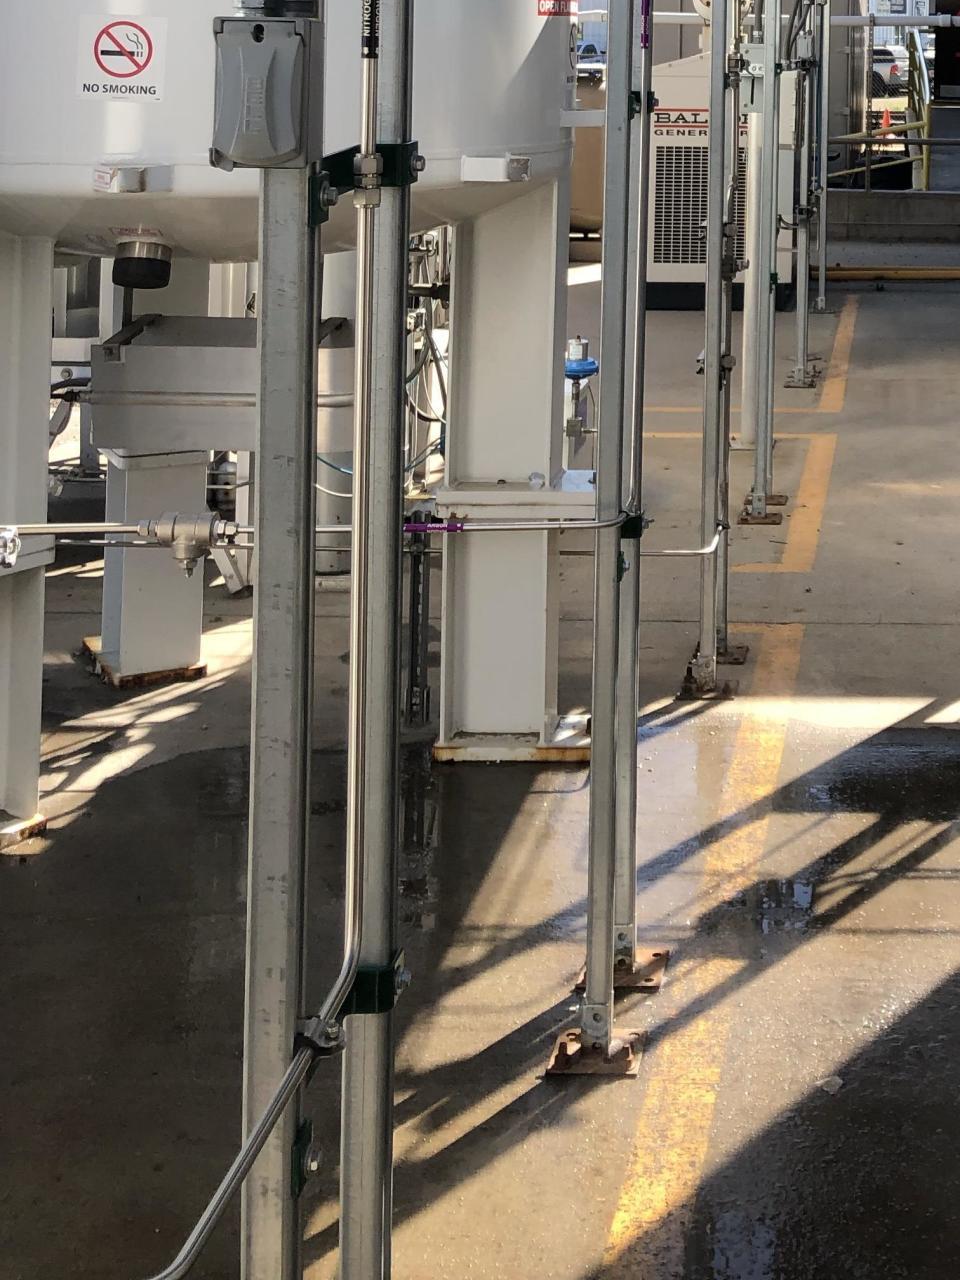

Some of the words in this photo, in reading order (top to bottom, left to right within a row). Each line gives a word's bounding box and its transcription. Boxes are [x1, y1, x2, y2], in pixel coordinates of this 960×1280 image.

[540, 0, 559, 13] OPEN
[82, 83, 100, 93] NO
[102, 83, 157, 95] SMOKING
